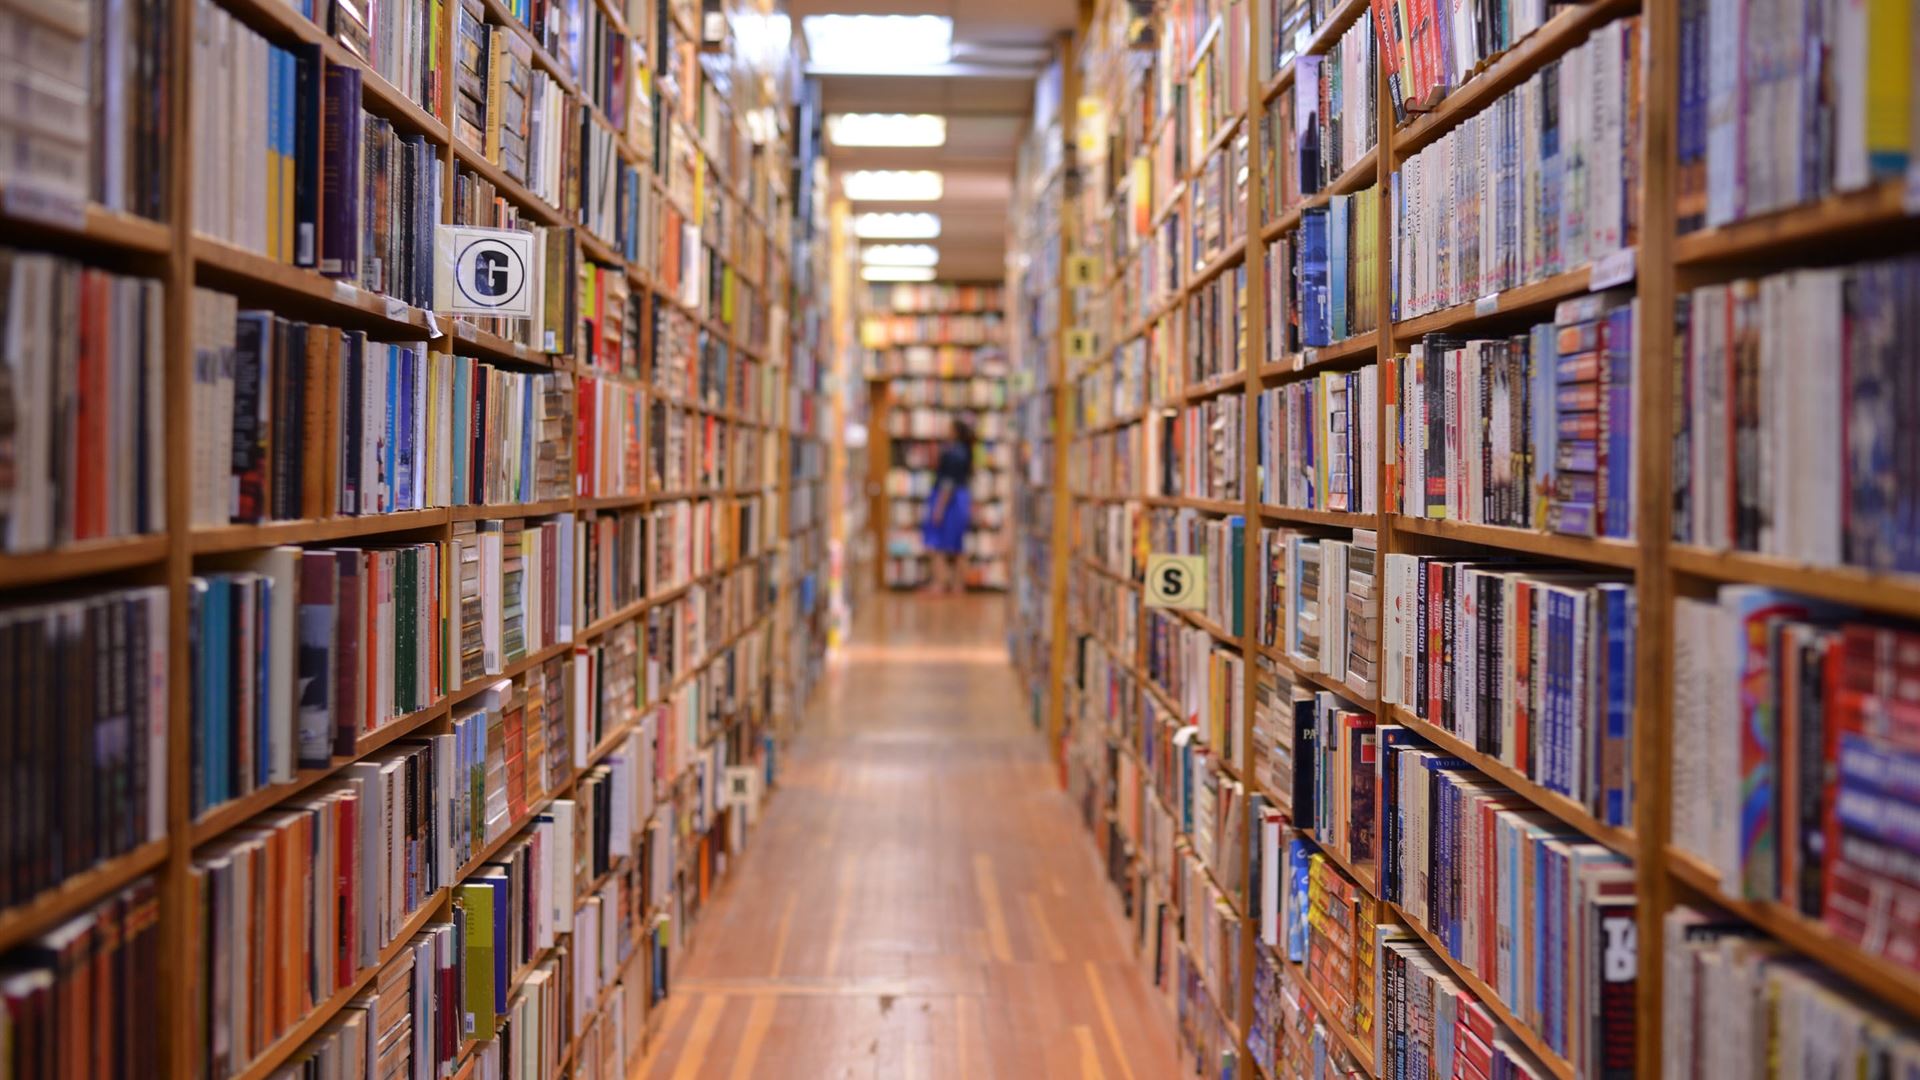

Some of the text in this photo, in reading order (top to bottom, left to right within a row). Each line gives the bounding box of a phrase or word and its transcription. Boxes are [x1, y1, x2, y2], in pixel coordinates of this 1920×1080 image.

[475, 250, 509, 297] G
[1163, 567, 1182, 596] S
[1417, 562, 1426, 603] sidney
[1418, 604, 1426, 653] sheldon
[1386, 969, 1394, 1040] THE CURE
[1397, 977, 1405, 1000] DAVID
